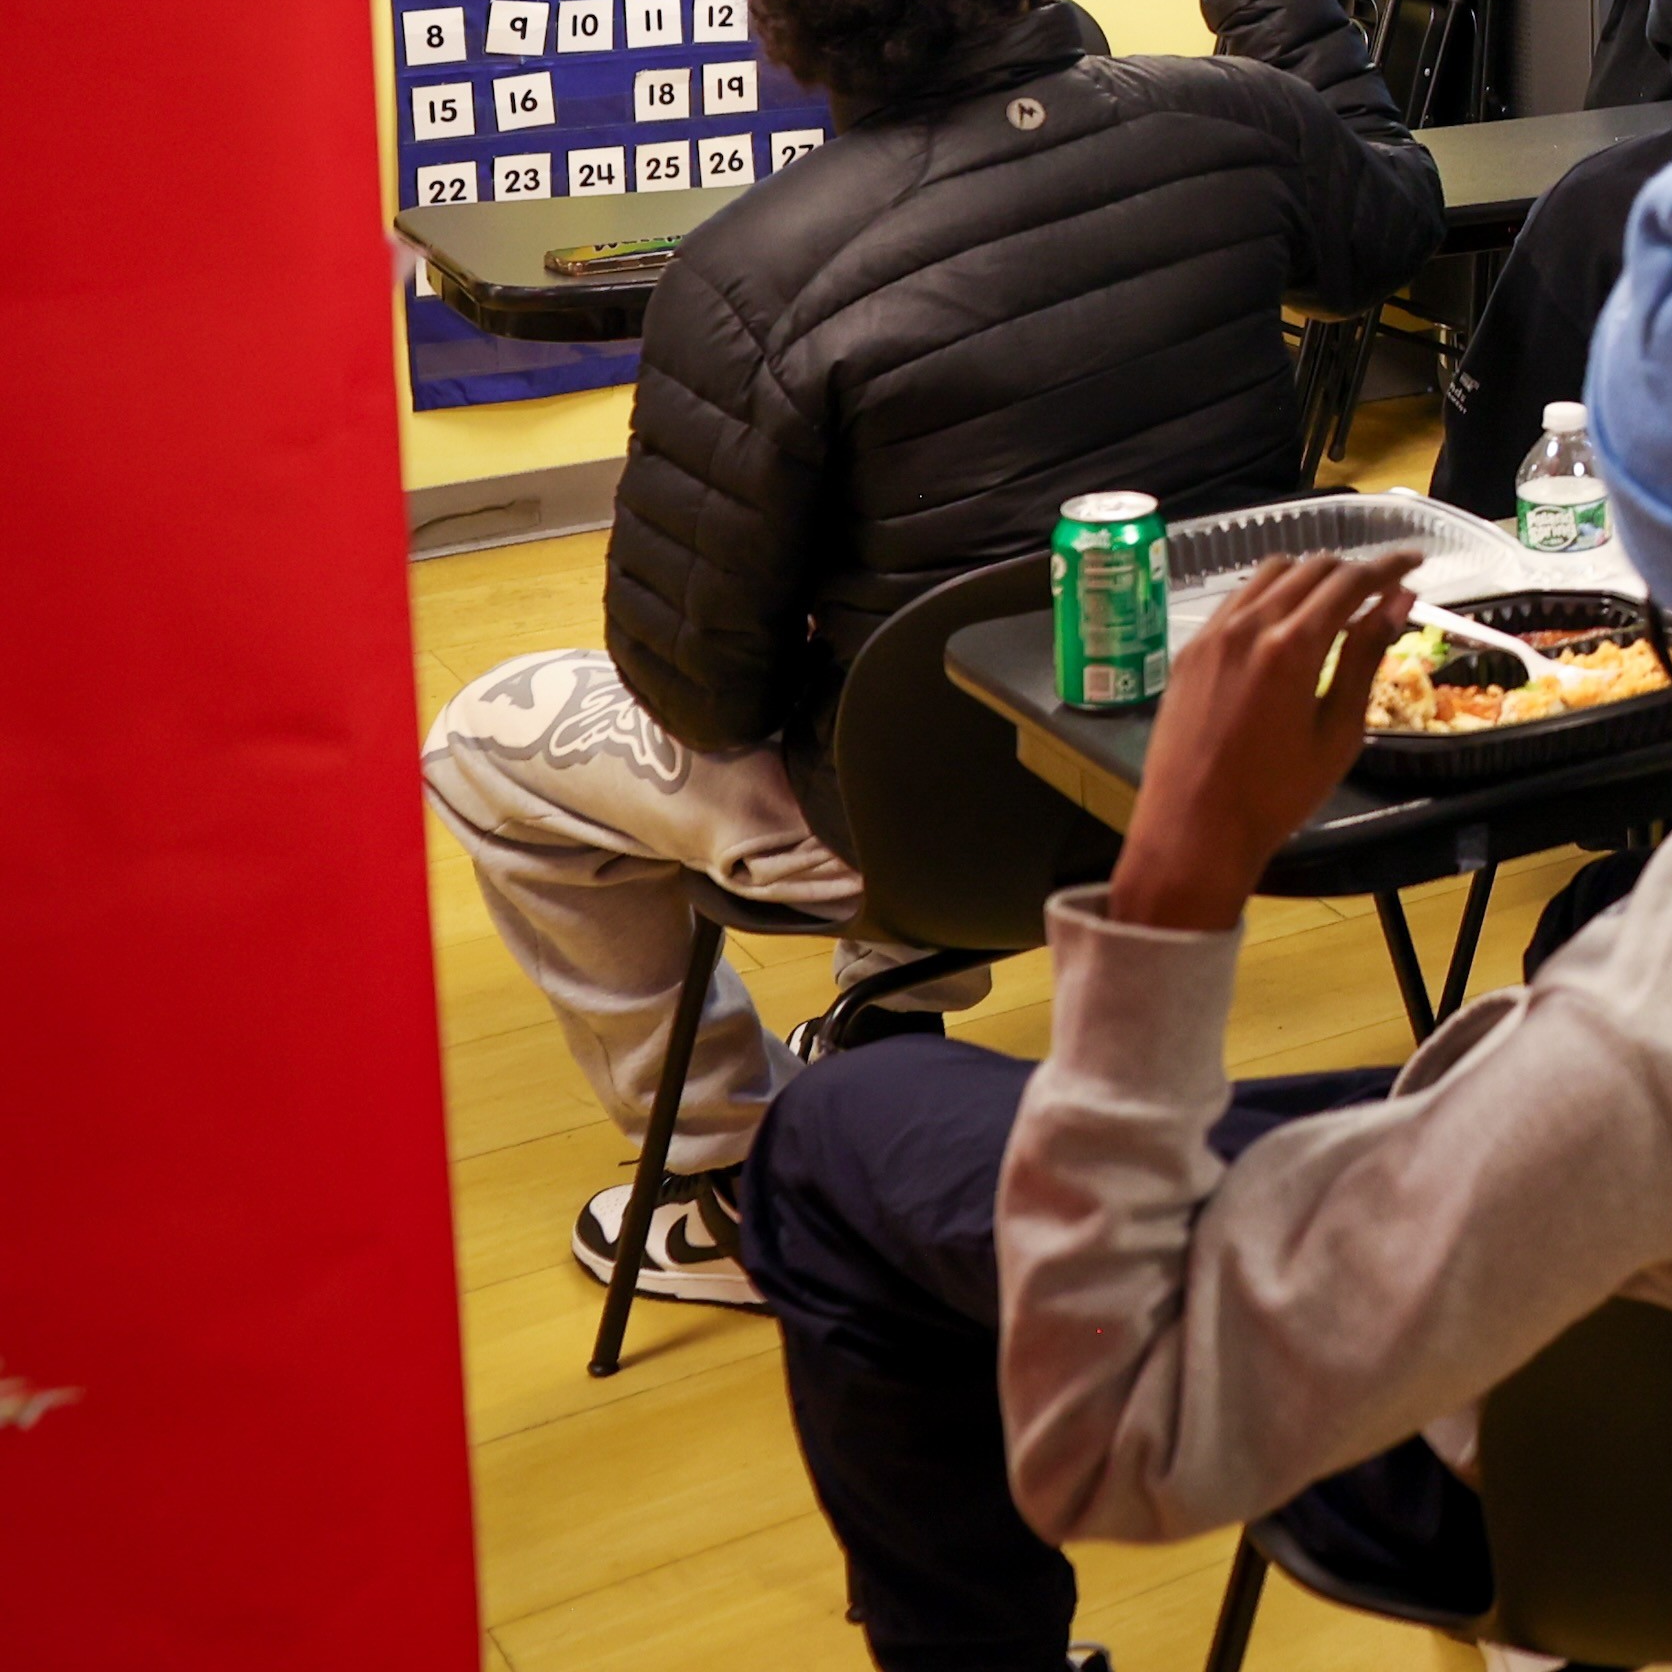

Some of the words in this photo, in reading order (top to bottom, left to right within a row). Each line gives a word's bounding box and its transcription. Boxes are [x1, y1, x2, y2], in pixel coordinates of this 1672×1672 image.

[426, 24, 445, 48] 8
[510, 16, 528, 40] 9
[572, 13, 599, 37] 10
[645, 9, 663, 31] 11
[707, 5, 734, 28] 12
[428, 98, 458, 124] 15
[510, 89, 538, 114] 16
[649, 82, 675, 106] 18
[717, 76, 744, 99] 19
[428, 177, 467, 204] 22
[504, 168, 540, 194] 23
[578, 163, 615, 187] 24
[645, 156, 681, 180] 25
[709, 149, 744, 174] 26
